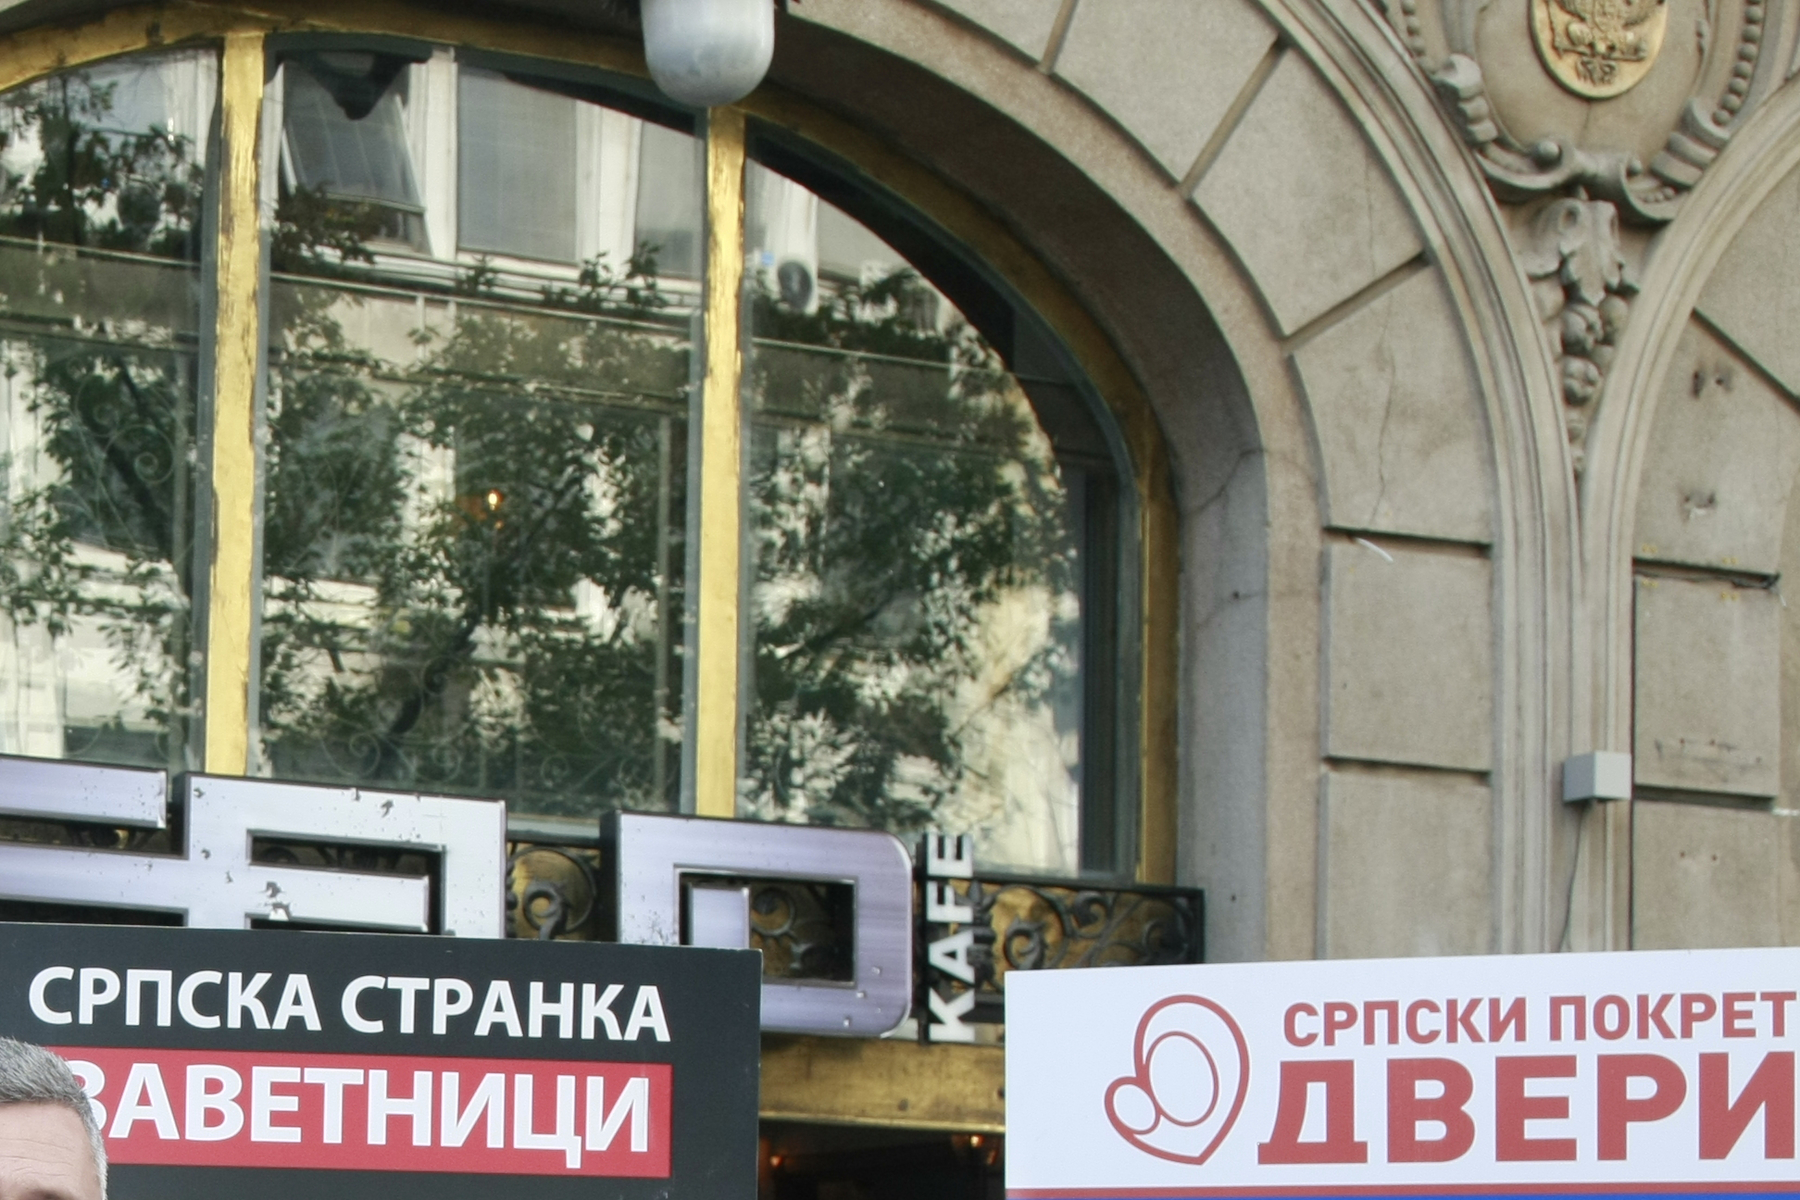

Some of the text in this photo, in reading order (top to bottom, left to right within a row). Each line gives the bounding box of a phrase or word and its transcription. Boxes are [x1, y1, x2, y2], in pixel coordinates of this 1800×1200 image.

[926, 831, 976, 1043] KAFE
[28, 966, 671, 1042] СРПСКА СТРАНКА
[1284, 992, 1797, 1047] СРПСКИ ПОКРЕТ
[1258, 1051, 1796, 1165] ДВЕРИ
